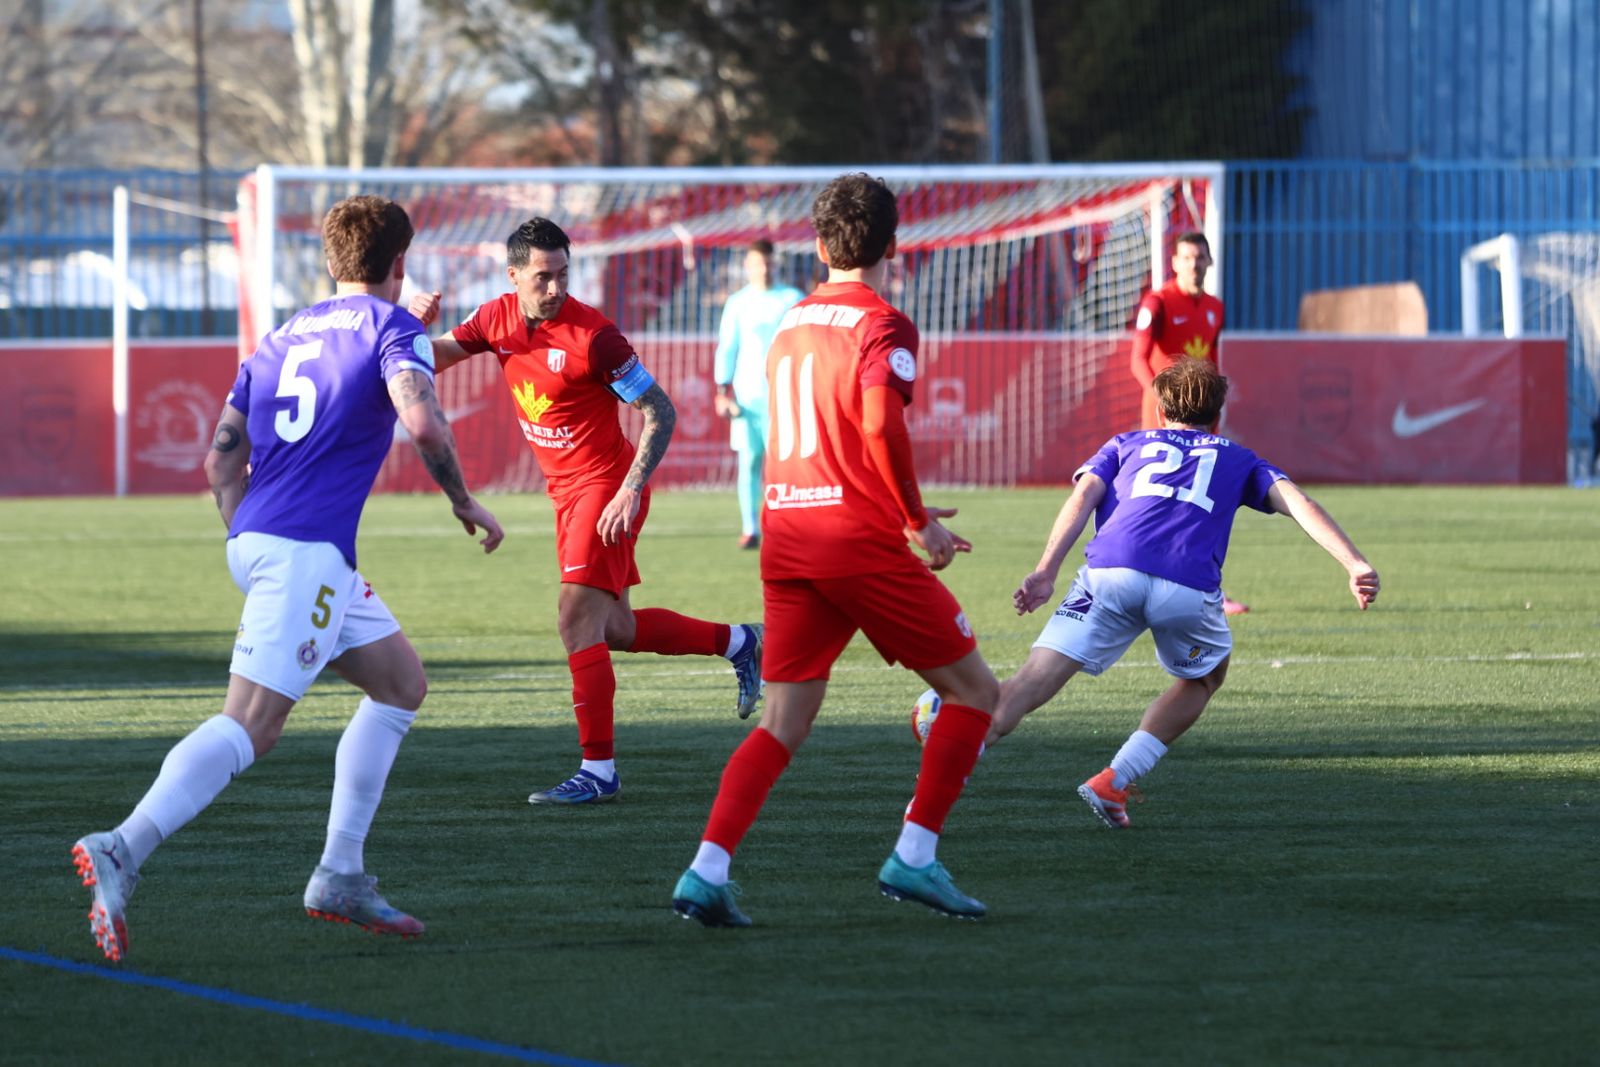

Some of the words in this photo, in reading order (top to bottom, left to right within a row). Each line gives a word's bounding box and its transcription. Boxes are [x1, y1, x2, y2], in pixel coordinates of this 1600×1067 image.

[273, 339, 325, 443] 5
[775, 352, 817, 462] 11
[1145, 431, 1161, 439] R.
[1167, 433, 1230, 447] VALLEJO
[1130, 441, 1218, 513] 21
[311, 584, 335, 630] 5
